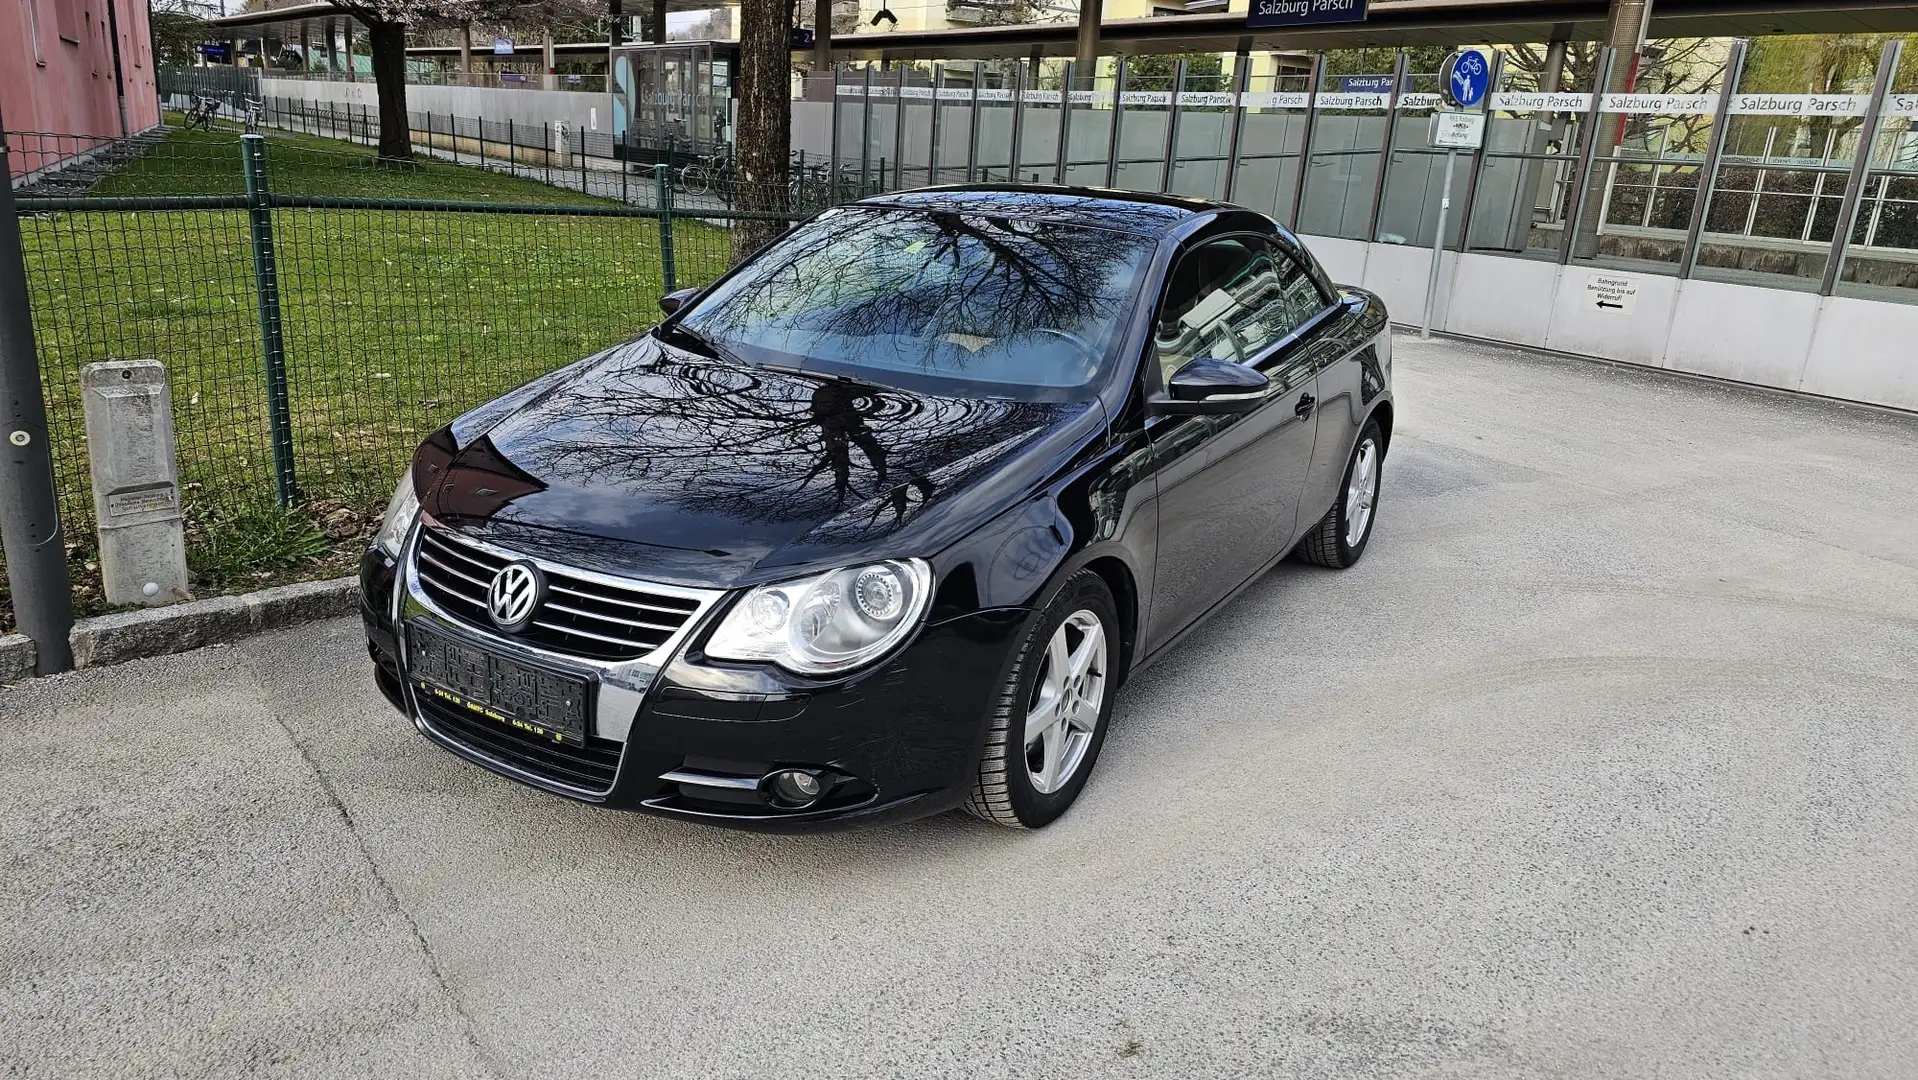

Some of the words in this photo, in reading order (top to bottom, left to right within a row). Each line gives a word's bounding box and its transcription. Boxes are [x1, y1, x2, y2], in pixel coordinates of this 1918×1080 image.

[1259, 0, 1309, 17] Salzburg
[1312, 0, 1353, 11] Parsch
[804, 33, 810, 43] 2
[1348, 78, 1378, 88] Salzburg
[1381, 79, 1393, 87] Par
[1122, 94, 1147, 103] Salzburg
[1181, 94, 1207, 105] Salzburg
[1279, 95, 1303, 105] Parsch
[1320, 95, 1353, 107] Salzburg
[1355, 96, 1382, 106] Parsch
[1499, 95, 1543, 109] Salzburg
[1547, 95, 1583, 108] Parsch
[1609, 96, 1662, 111] Salzburg
[1666, 97, 1707, 109] Parsch
[1740, 97, 1802, 113] Salzburg
[1807, 98, 1857, 111] Parsch
[1597, 278, 1628, 287] Bahngrund
[1587, 284, 1616, 294] Benützung
[491, 564, 537, 625] VW
